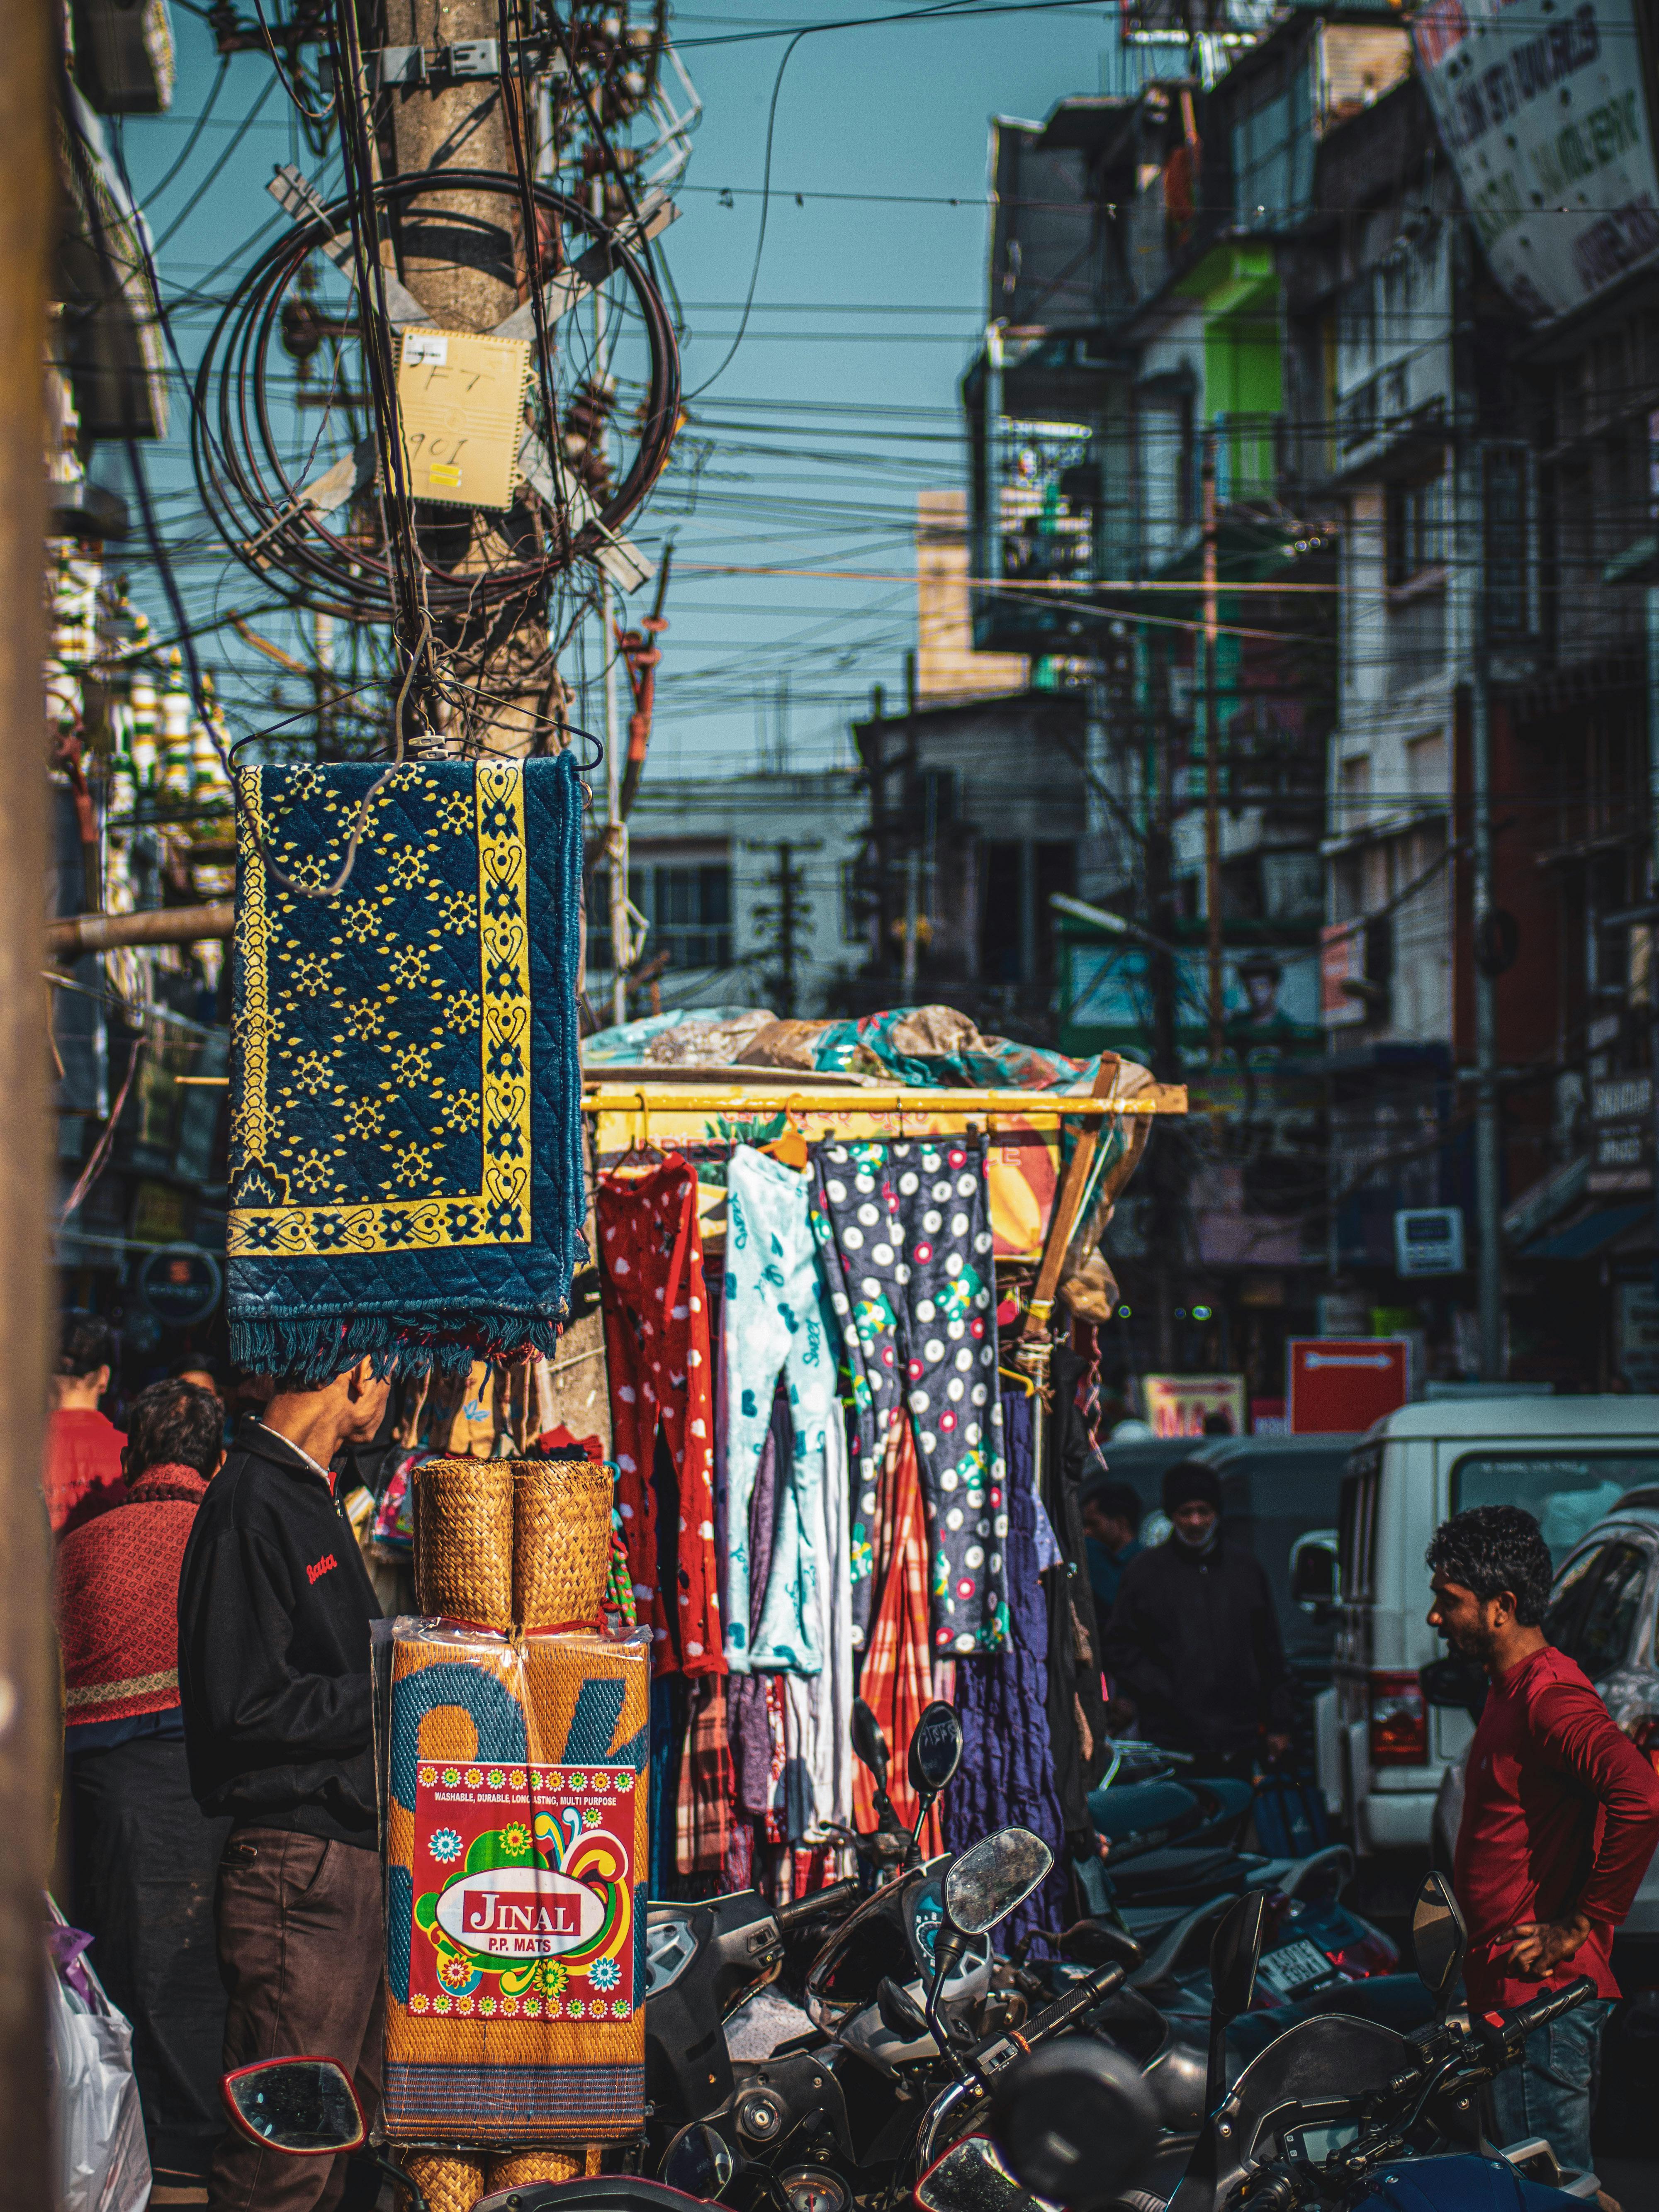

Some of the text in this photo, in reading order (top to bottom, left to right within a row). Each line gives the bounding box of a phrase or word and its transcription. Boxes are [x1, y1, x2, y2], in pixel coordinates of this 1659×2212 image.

[410, 433, 468, 465] 901
[435, 1792, 475, 1803] WASHABLE,
[477, 1793, 511, 1804] DURABLE,
[532, 1795, 558, 1806] ASTING,
[560, 1796, 581, 1805] MULTI
[584, 1797, 617, 1806] PURPOSE
[470, 1893, 574, 1932] JINAL
[489, 1937, 551, 1953] P.P. MATS
